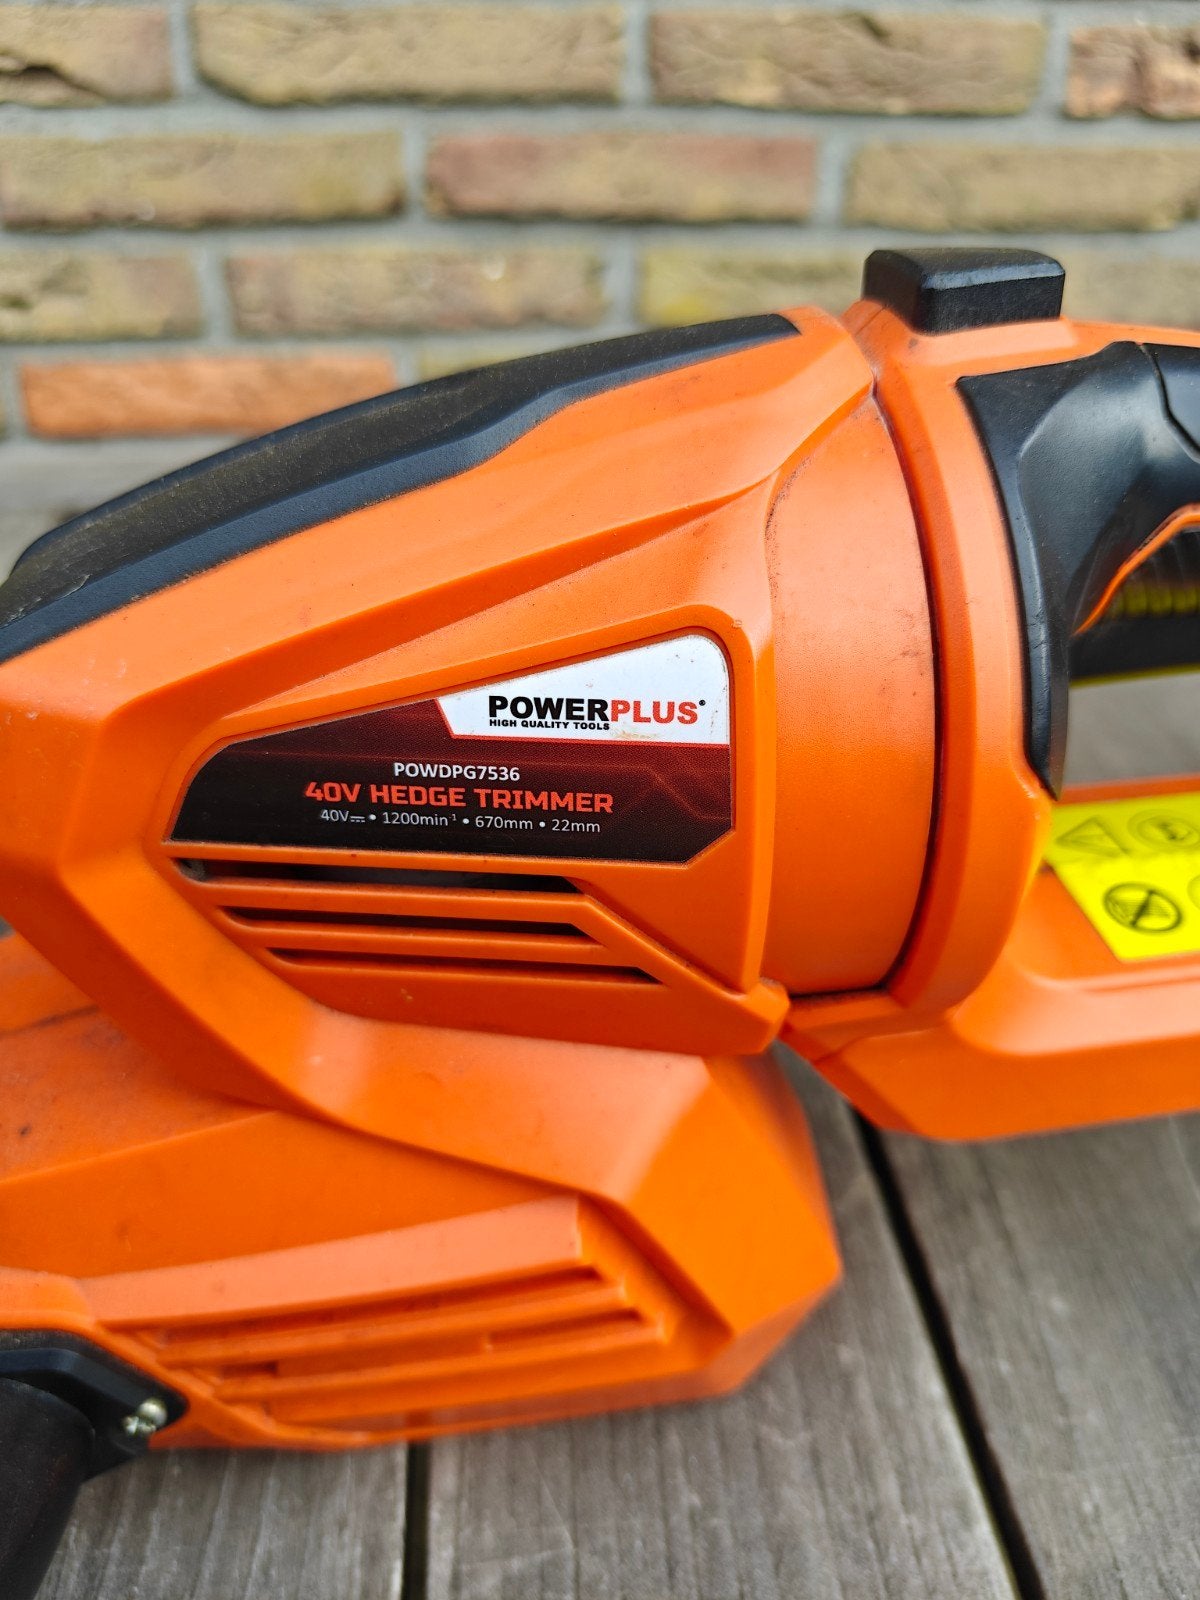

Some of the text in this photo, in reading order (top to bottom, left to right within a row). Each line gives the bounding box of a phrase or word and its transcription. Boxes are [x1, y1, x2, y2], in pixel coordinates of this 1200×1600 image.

[489, 718, 611, 731] HIGH QUALITY TOOLS
[393, 761, 521, 782] POWDPG7536
[304, 781, 614, 814] 40V HEDGE TRIMMER
[474, 815, 534, 830] 670mm
[551, 818, 601, 833] 22mm
